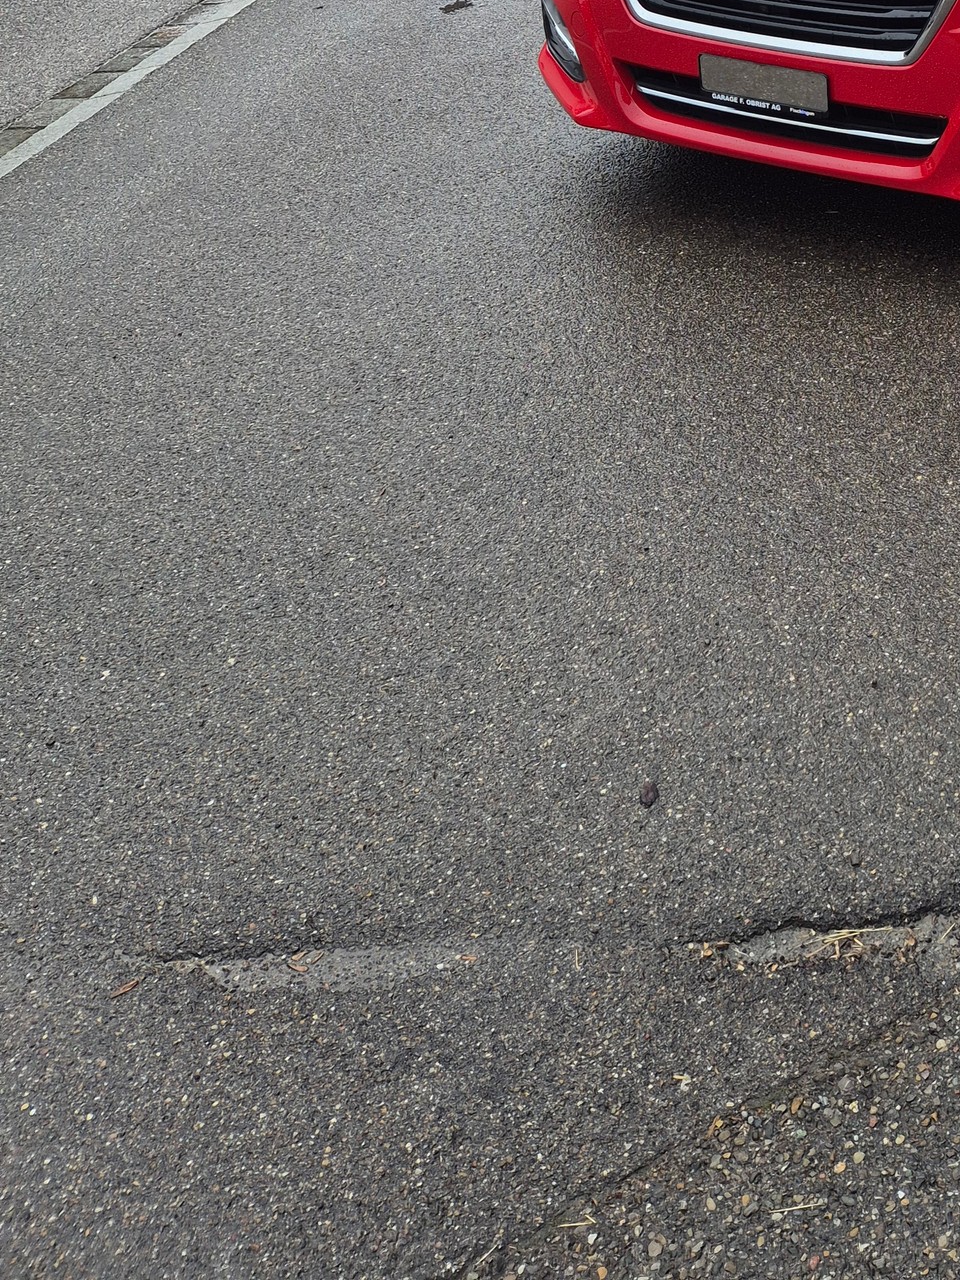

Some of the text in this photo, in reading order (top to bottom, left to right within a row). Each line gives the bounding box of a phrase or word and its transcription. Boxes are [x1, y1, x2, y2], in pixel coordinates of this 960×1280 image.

[711, 92, 738, 103] GARAGE
[746, 99, 770, 109] OBRIST
[771, 103, 781, 111] AG
